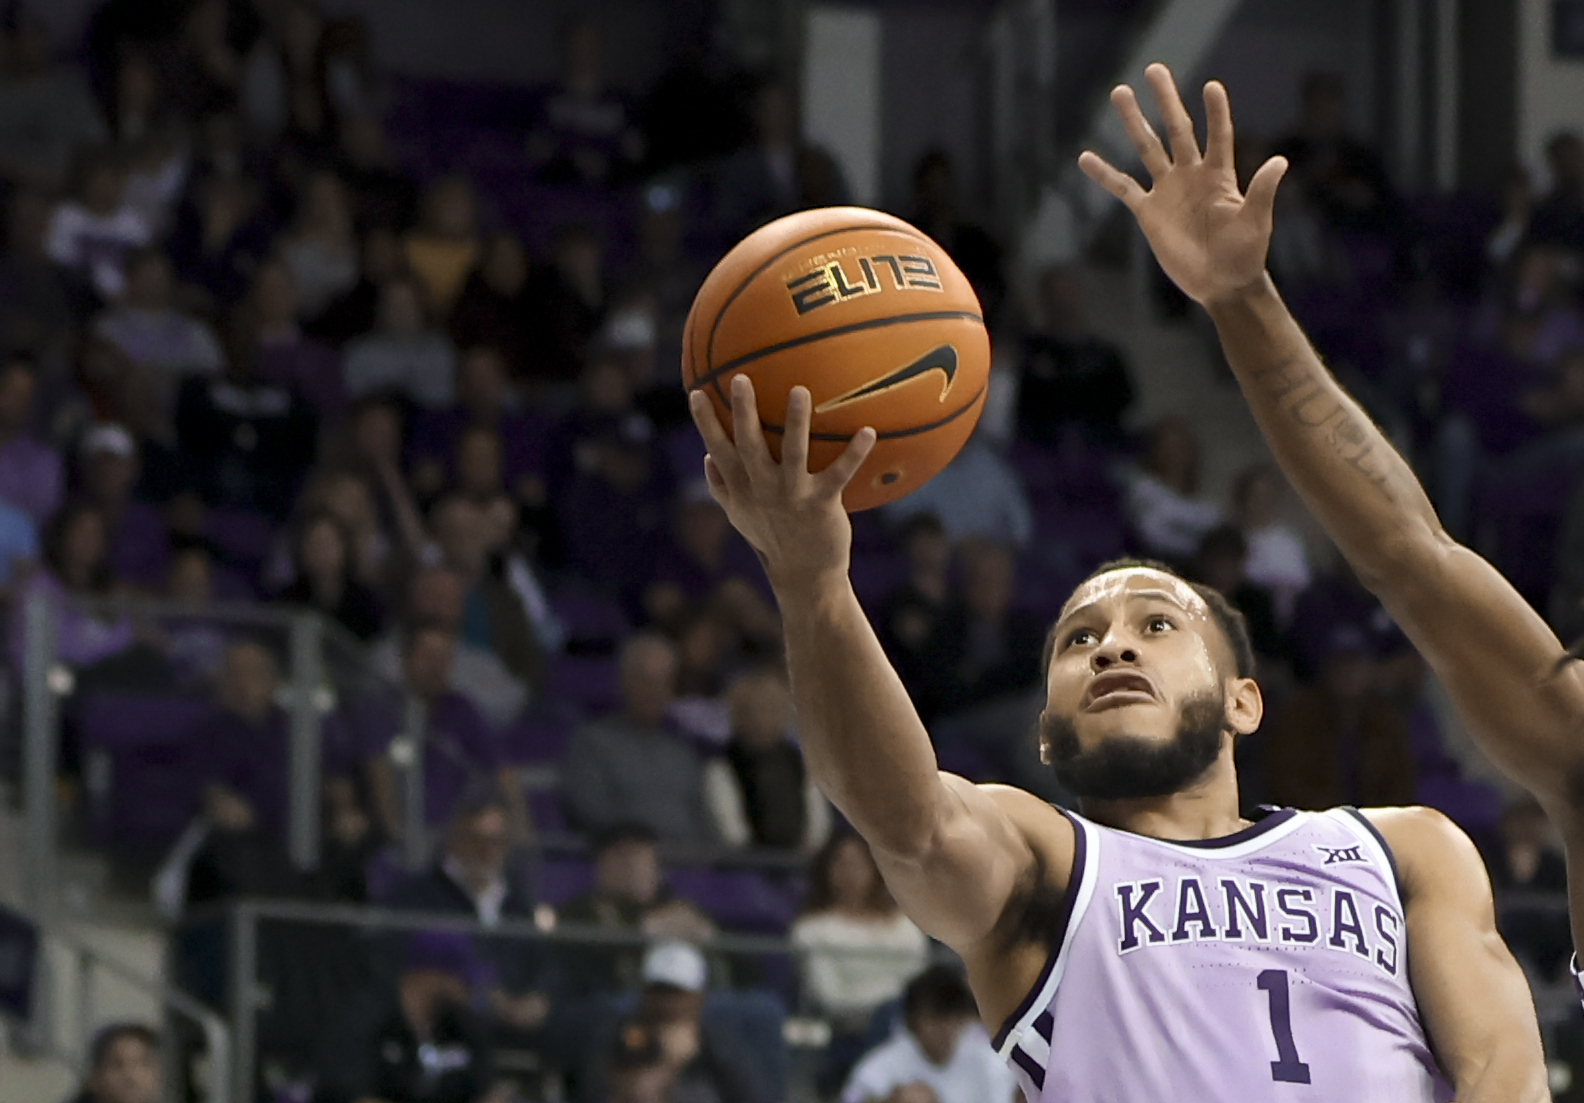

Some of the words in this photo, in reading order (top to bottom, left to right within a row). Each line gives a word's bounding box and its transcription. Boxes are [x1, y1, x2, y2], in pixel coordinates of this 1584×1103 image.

[785, 254, 944, 317] ELITE
[1115, 876, 1403, 976] KANSAS
[1256, 968, 1312, 1085] 1
